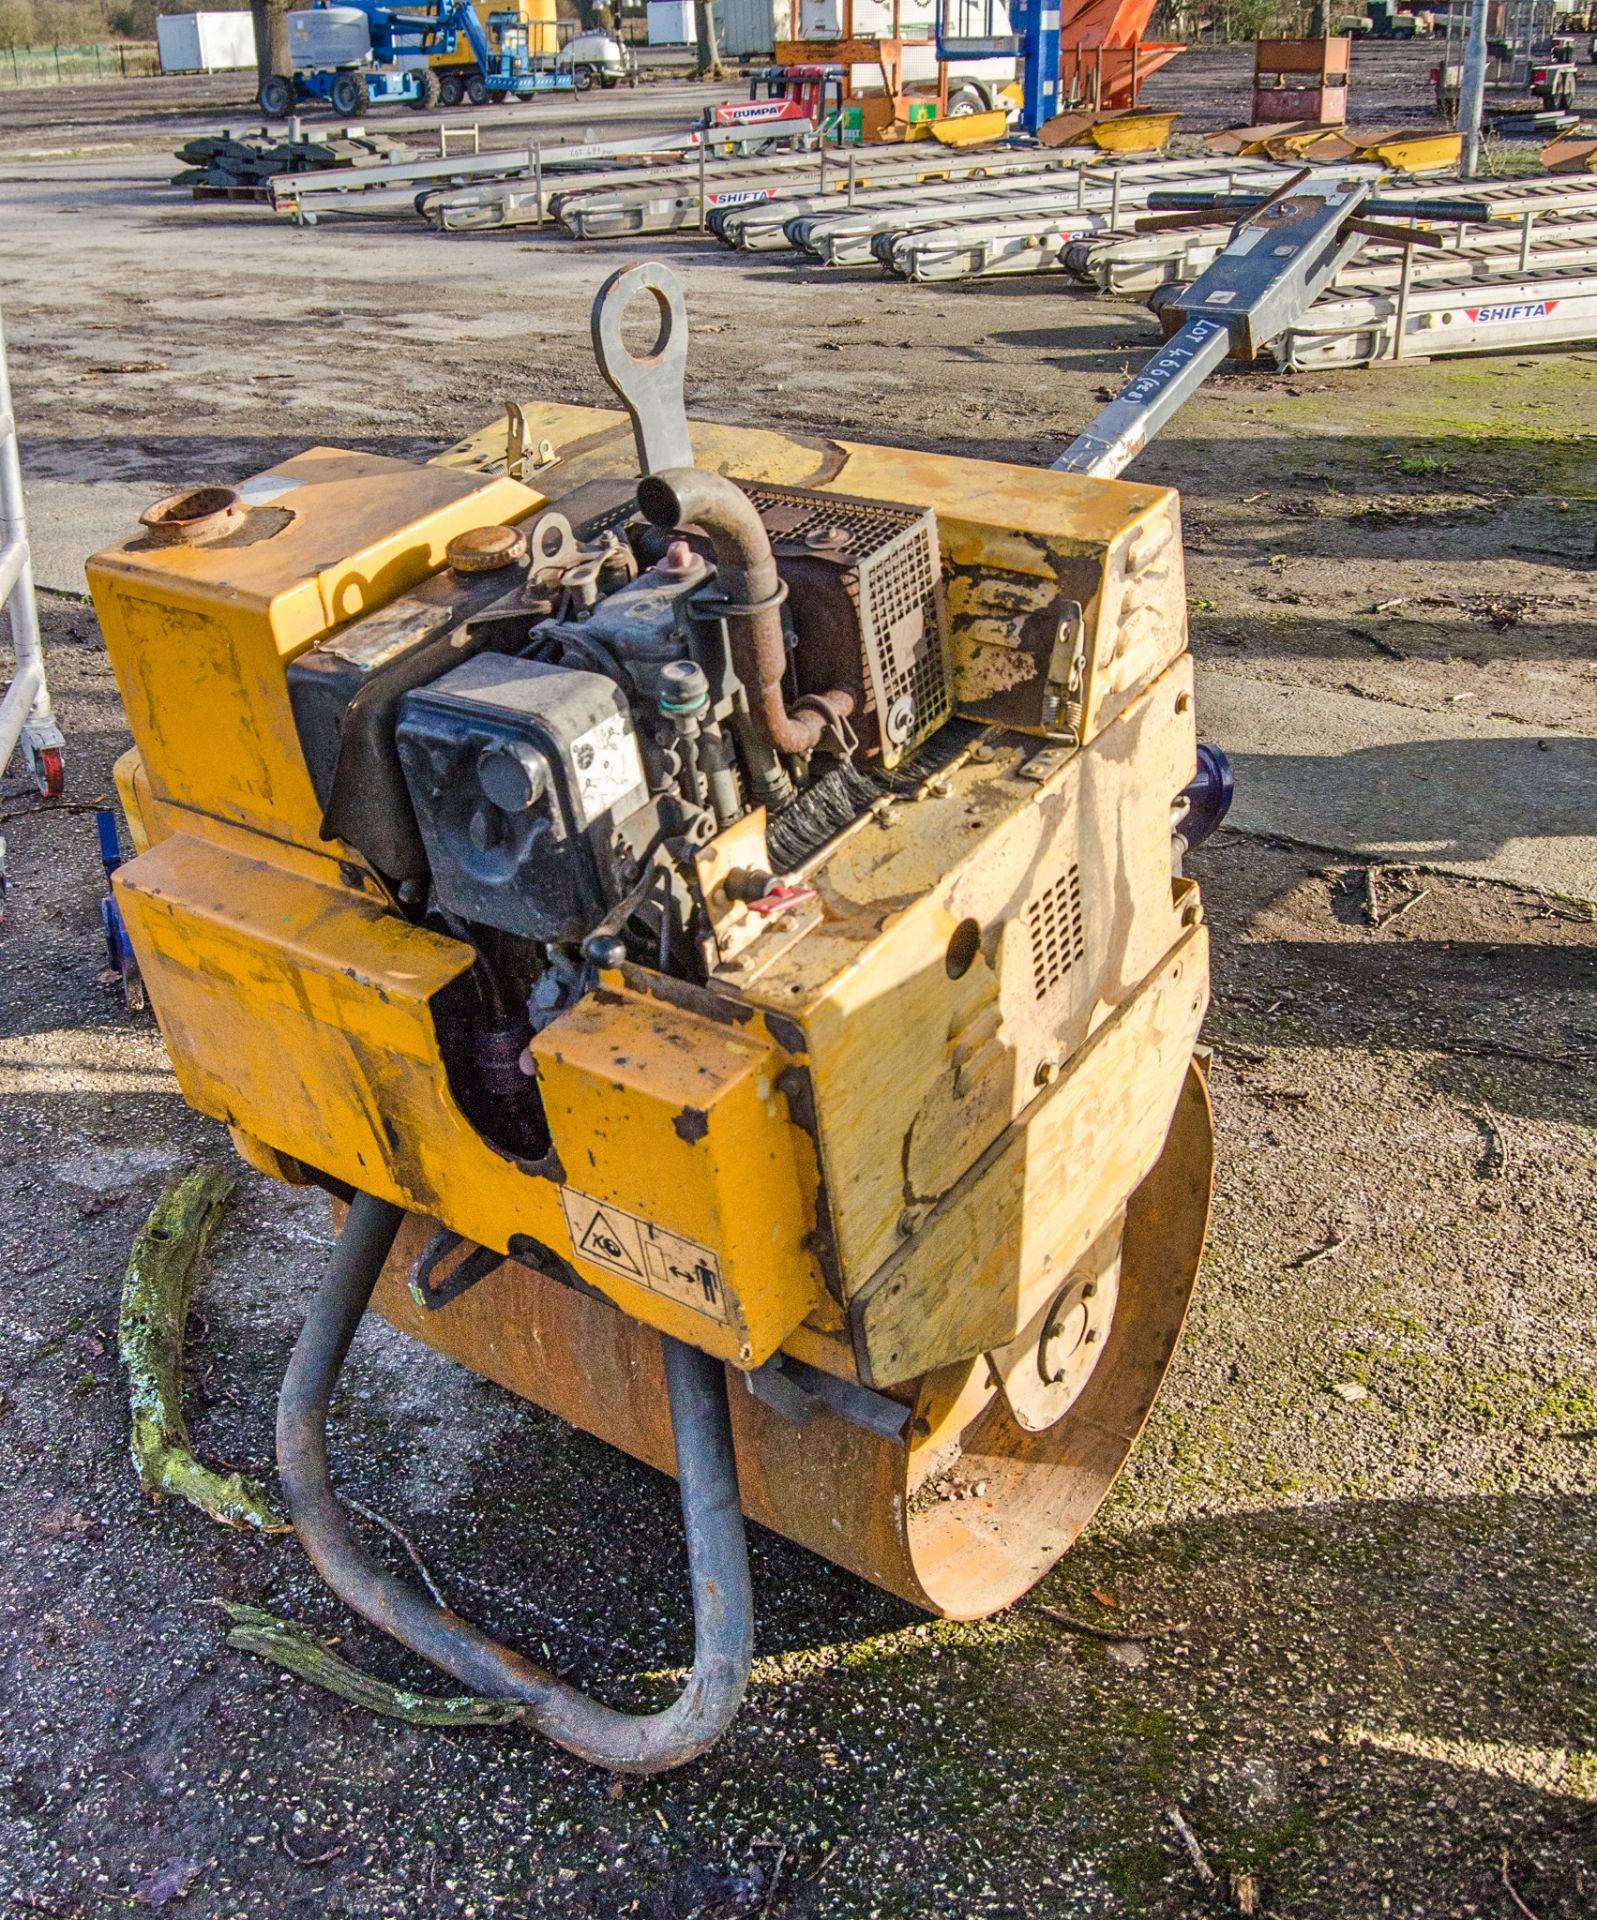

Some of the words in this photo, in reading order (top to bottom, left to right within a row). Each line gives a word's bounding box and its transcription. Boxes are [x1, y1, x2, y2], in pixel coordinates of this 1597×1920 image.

[733, 107, 777, 118] BUMPA
[718, 191, 768, 203] SHIFTA
[1478, 304, 1545, 321] SHIFTA
[1185, 319, 1220, 343] LOT
